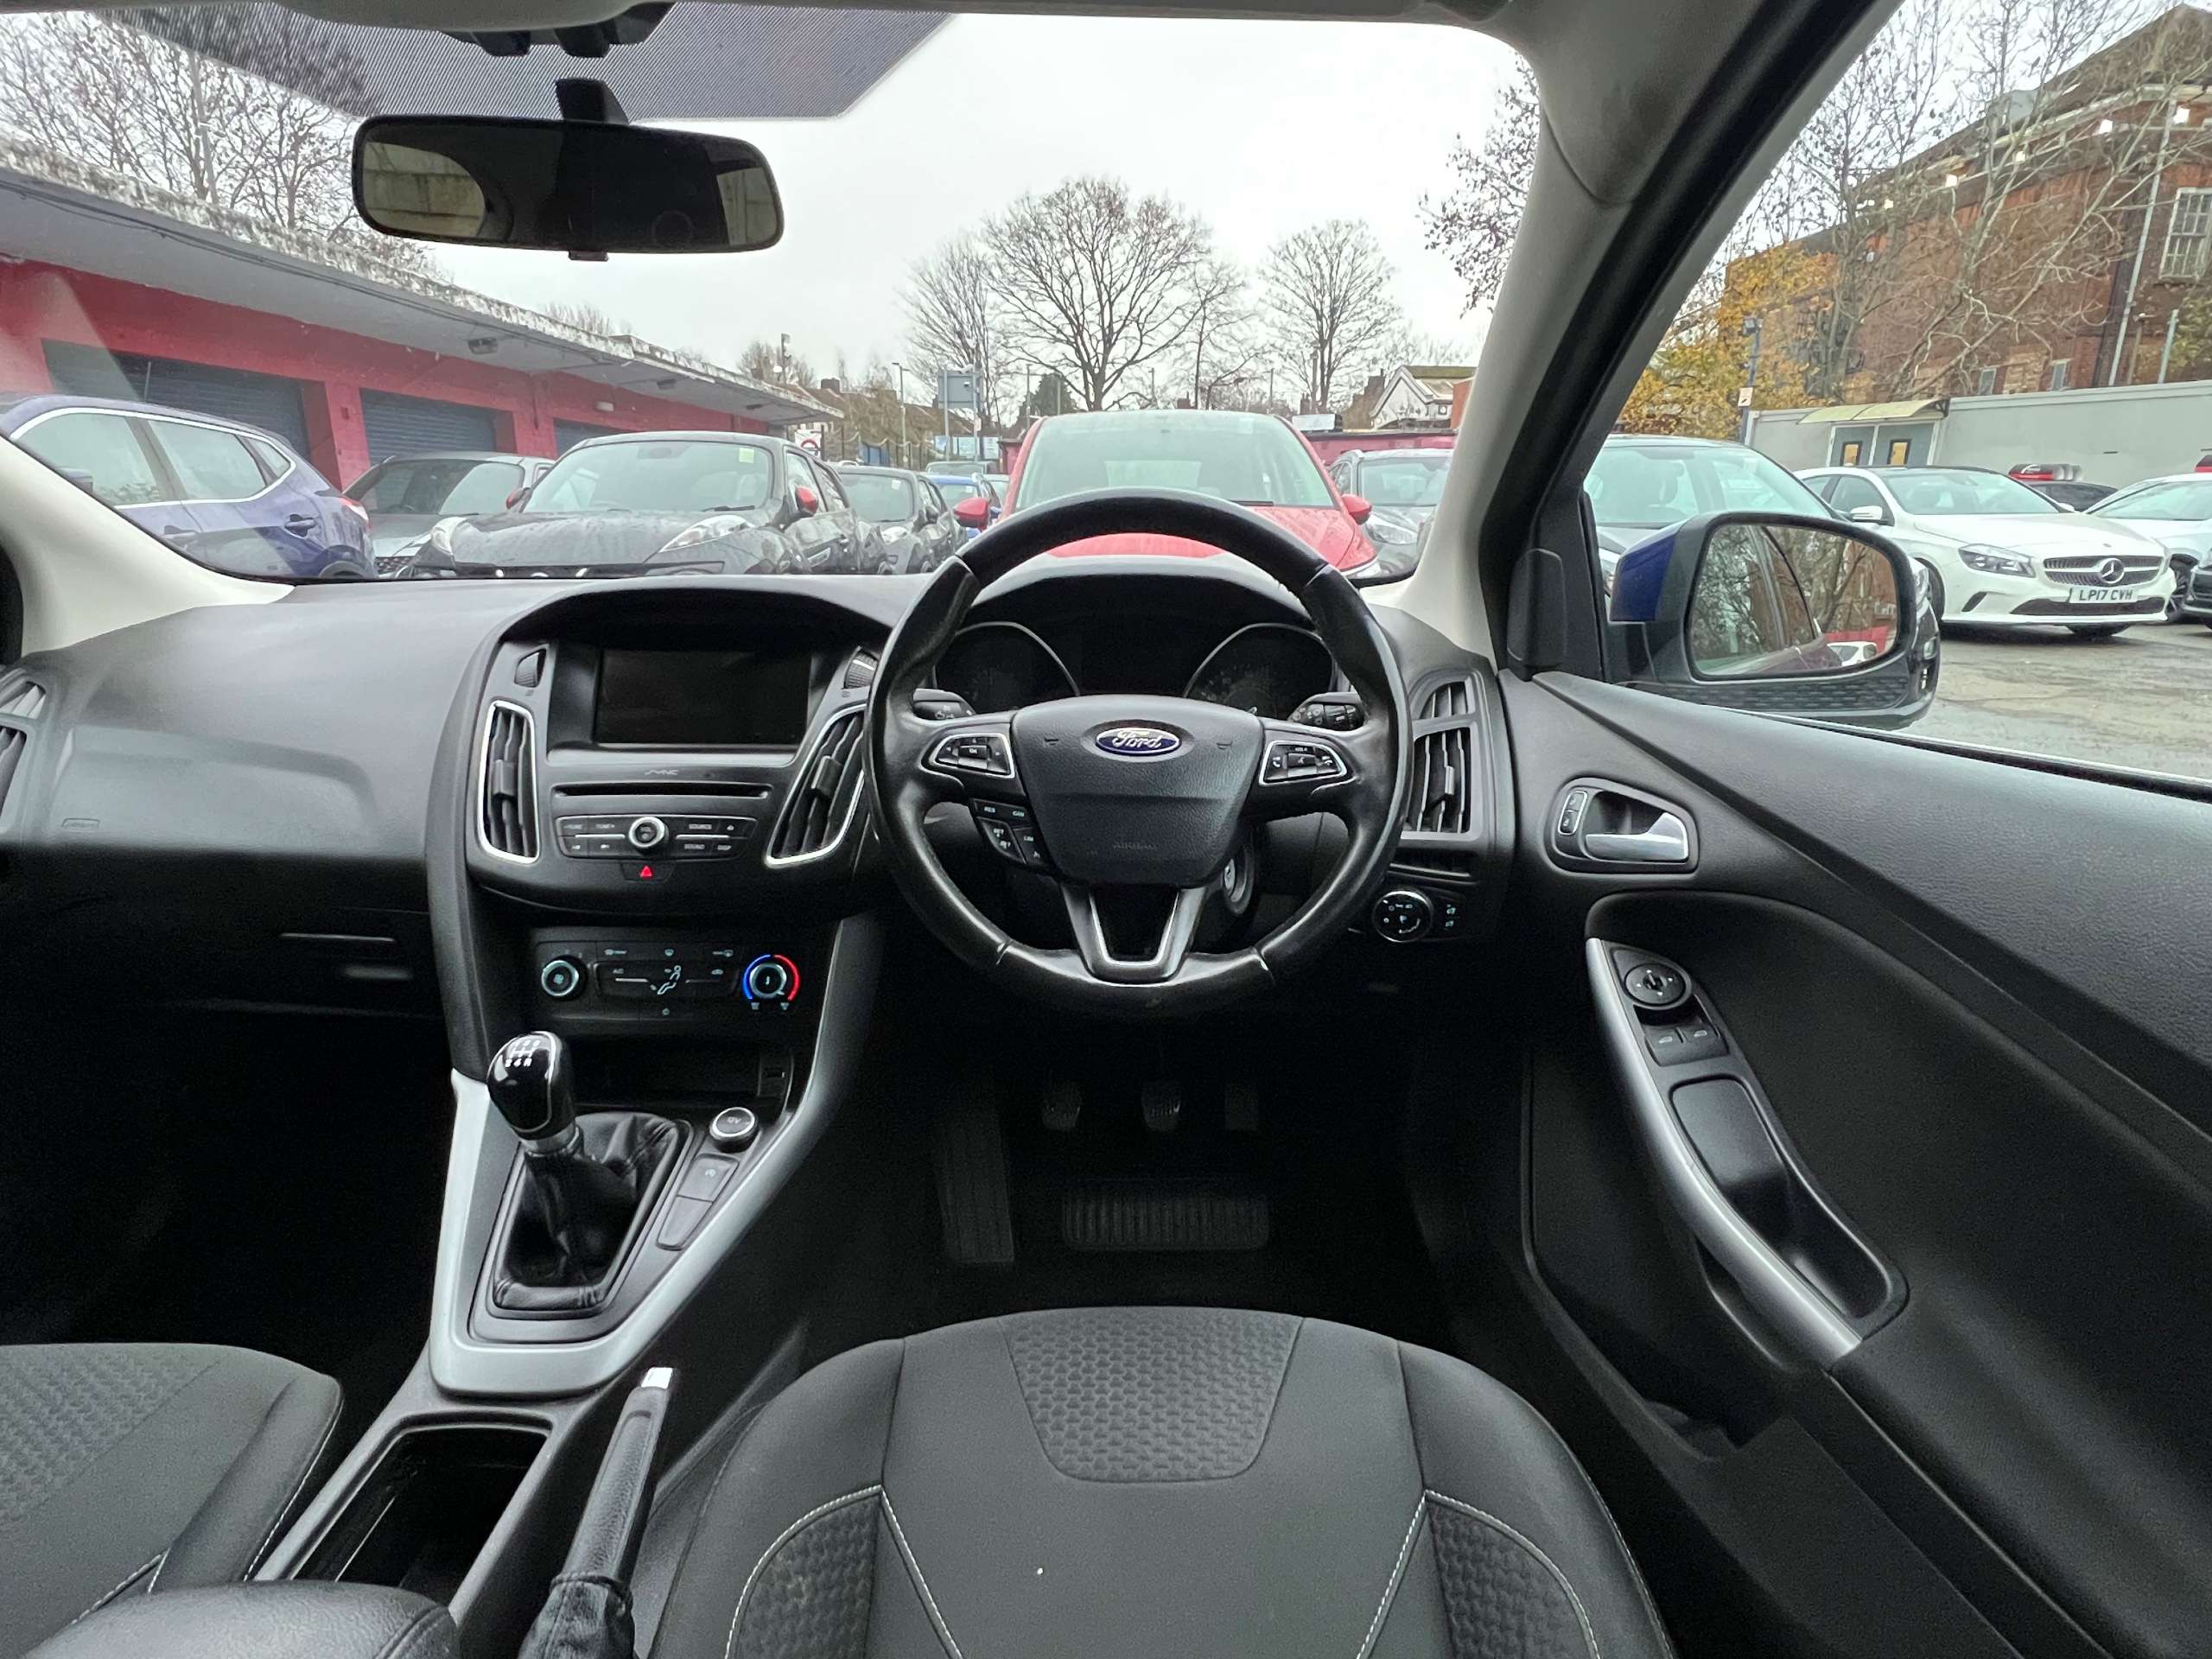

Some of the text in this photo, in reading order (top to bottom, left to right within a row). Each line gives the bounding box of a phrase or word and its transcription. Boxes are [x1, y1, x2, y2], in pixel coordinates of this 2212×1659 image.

[2079, 589, 2133, 601] LP17 CVH
[1112, 730, 1162, 748] Ford
